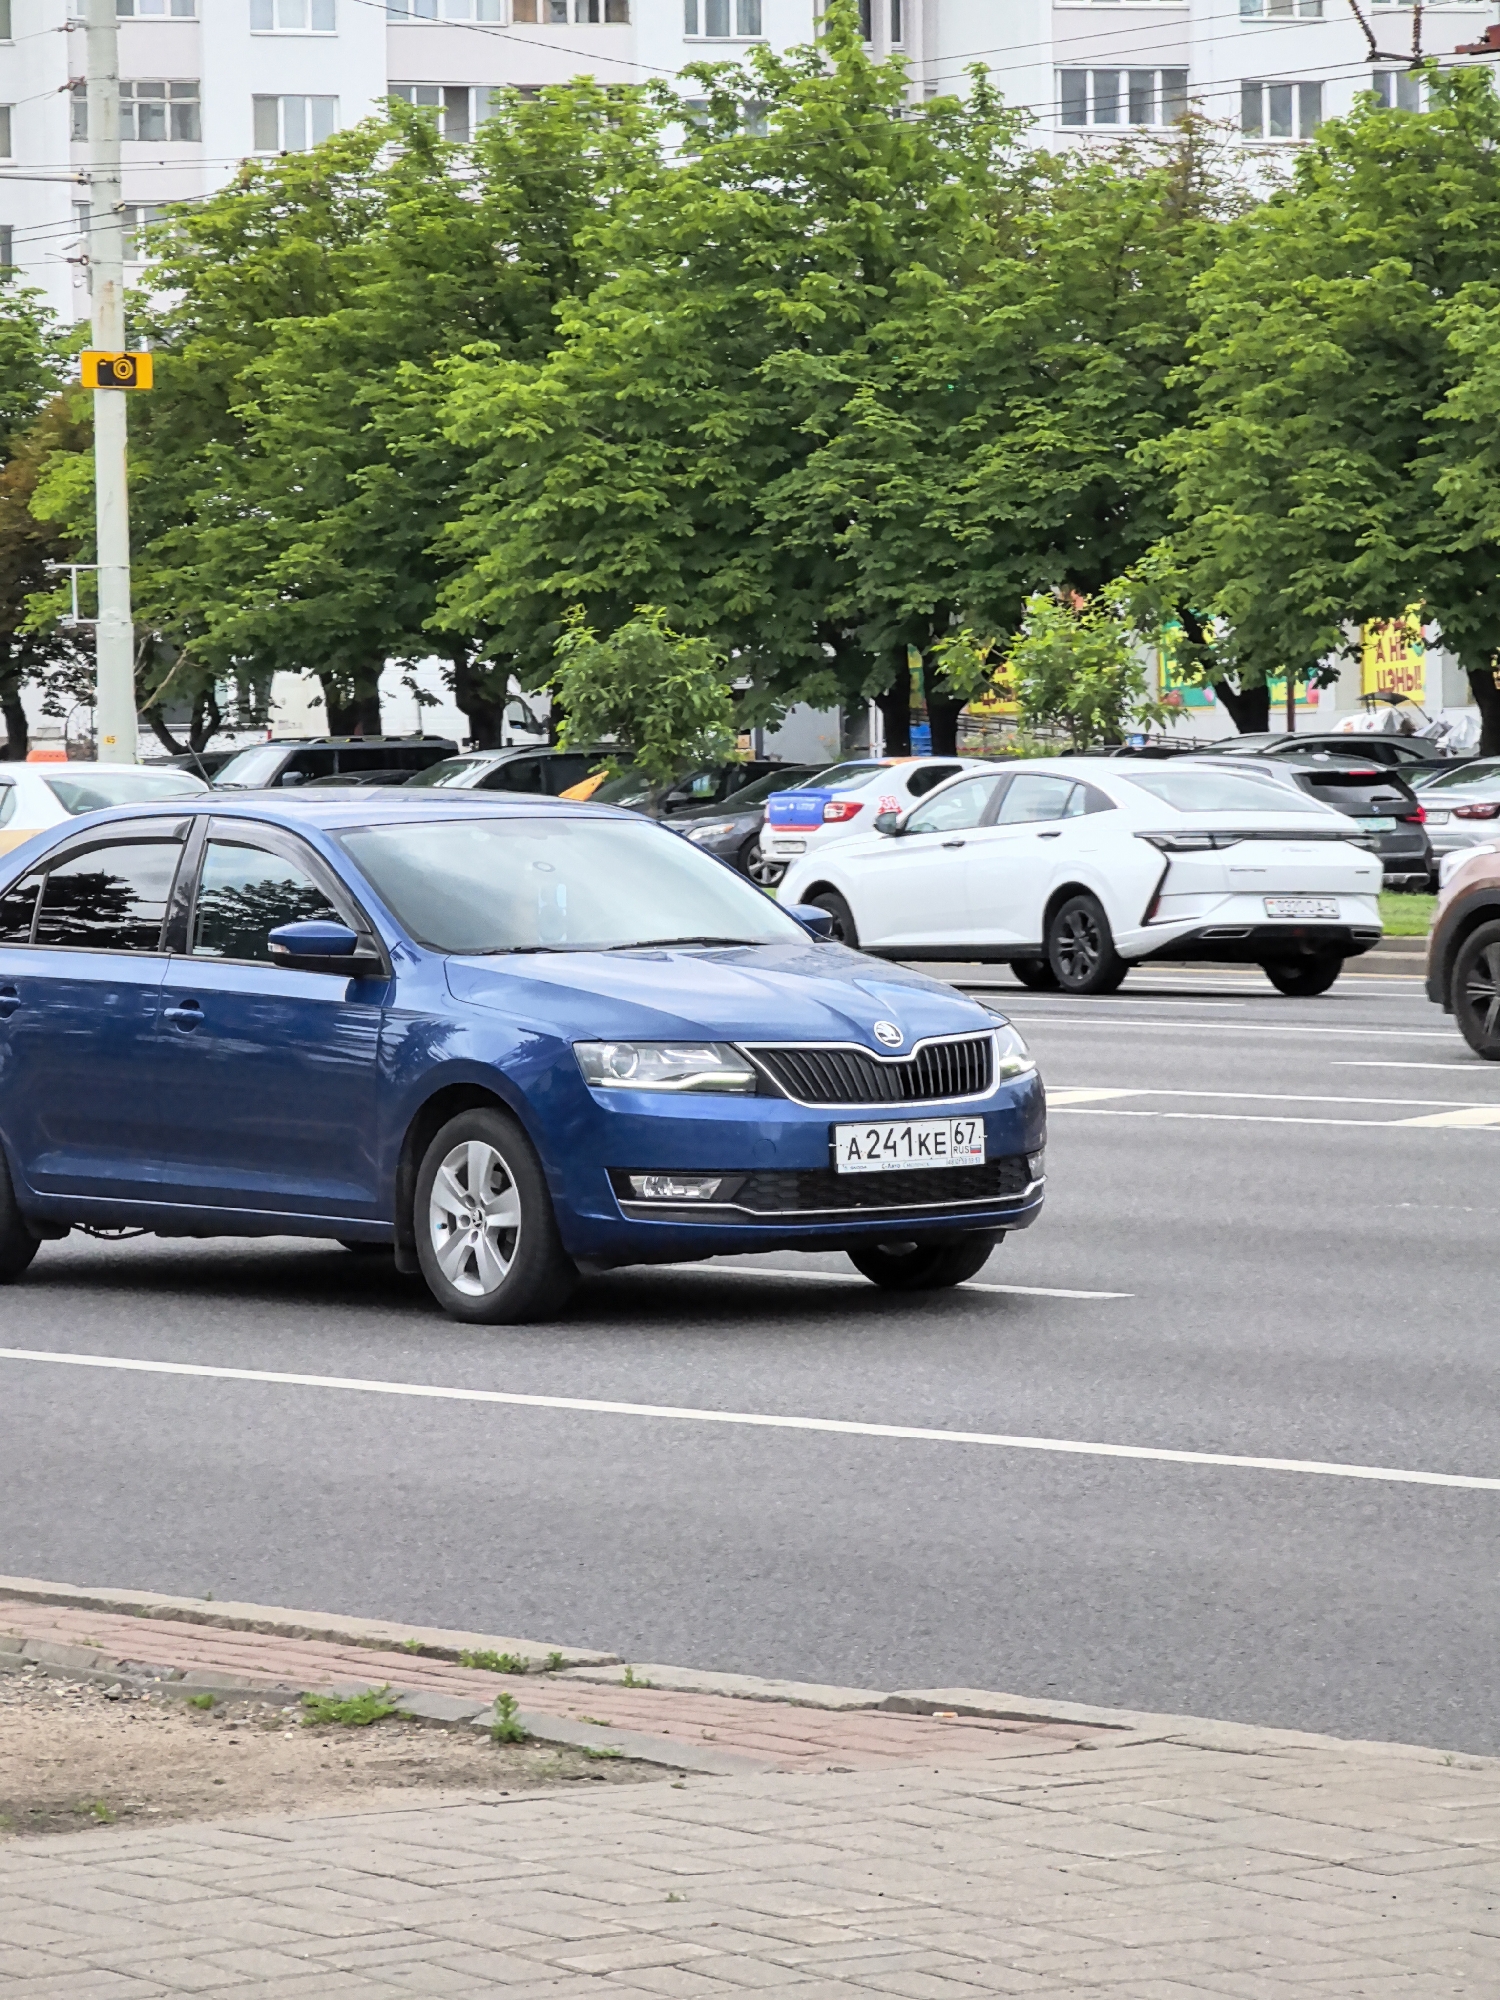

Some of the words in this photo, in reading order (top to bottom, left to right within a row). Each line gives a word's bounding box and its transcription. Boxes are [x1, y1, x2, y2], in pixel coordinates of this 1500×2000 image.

[1375, 638, 1386, 664] А
[954, 1121, 976, 1145] 67
[953, 1145, 970, 1154] RUS
